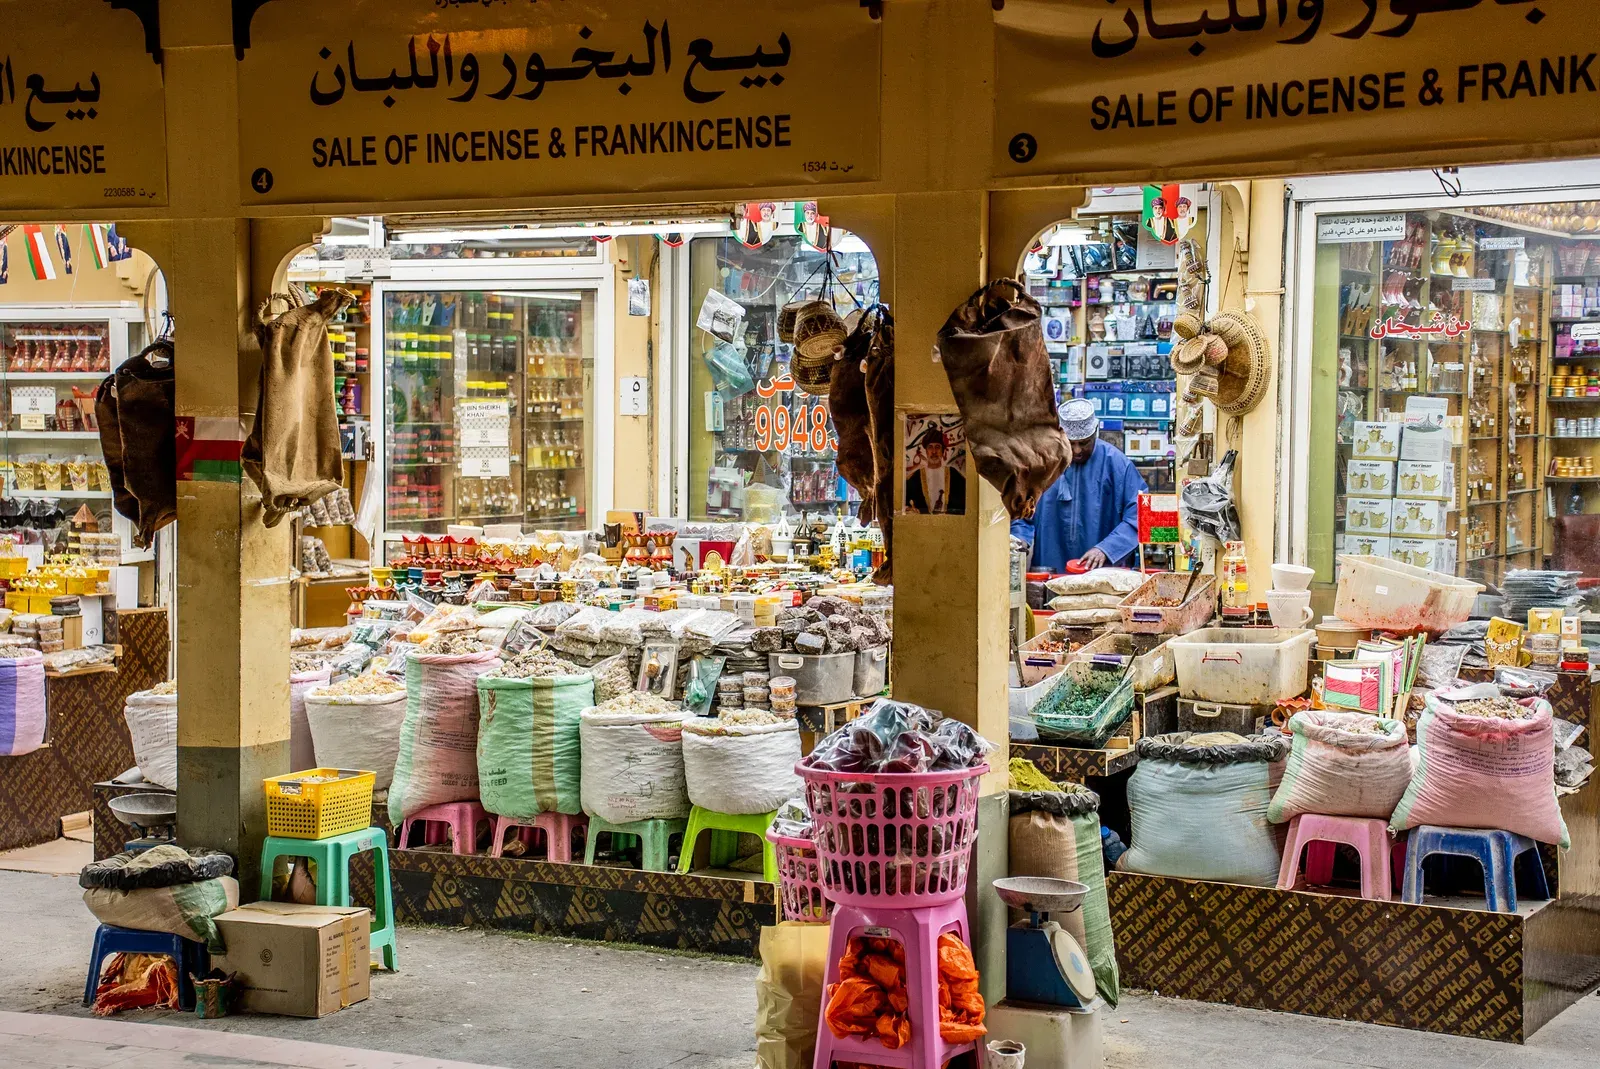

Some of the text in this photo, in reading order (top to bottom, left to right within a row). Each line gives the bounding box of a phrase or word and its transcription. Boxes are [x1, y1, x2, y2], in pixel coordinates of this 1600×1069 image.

[310, 18, 791, 109] بيع البخور واللبان
[25, 71, 101, 133] بيع
[1090, 53, 1600, 131] SALE OF INCENSE & FRANK
[0, 145, 106, 176] KINCENSE
[312, 114, 792, 168] SALE OF INCENSE & FRANKINCENSE
[801, 161, 827, 173] 1534
[103, 187, 136, 198] 2230585
[1370, 312, 1446, 340] شيخان
[98, 649, 136, 700] ALPHAPLEX
[104, 658, 142, 709] ALPHAPLEX
[111, 666, 147, 717] ALPHAPLEX
[54, 695, 93, 748] ALPHAPLEX
[61, 703, 99, 756] ALPHAPLEX
[67, 711, 106, 765] ALPHAPLEX
[73, 719, 112, 773] ALPHAPLEX
[14, 750, 54, 805] ALPHAPLEX
[79, 728, 117, 781] ALPHAPLEX
[86, 736, 124, 789] ALPHAPLEX
[490, 777, 508, 787] FEED
[21, 758, 60, 814] ALPHAPLEX
[28, 766, 67, 822] ALPHAPLEX
[34, 774, 73, 830] ALPHAPLEX
[40, 783, 79, 838] ALPHAPLEX
[1115, 886, 1177, 949] ALPHAPLEX
[1124, 900, 1187, 963] ALPHAPLEX
[1135, 913, 1199, 976] ALPHAPLEX
[1234, 893, 1301, 957] ALPHAPLEX
[1245, 907, 1312, 972] ALPHAPLEX
[1256, 922, 1324, 986] ALPHAPLEX
[1267, 935, 1336, 1000] ALPHAPLEX
[1372, 915, 1444, 980] ALPHAPLEX
[1384, 930, 1457, 997] ALPHAPLEX
[1397, 945, 1470, 1011] ALPHAPLEX
[1410, 960, 1482, 1024] ALPHAPLEX
